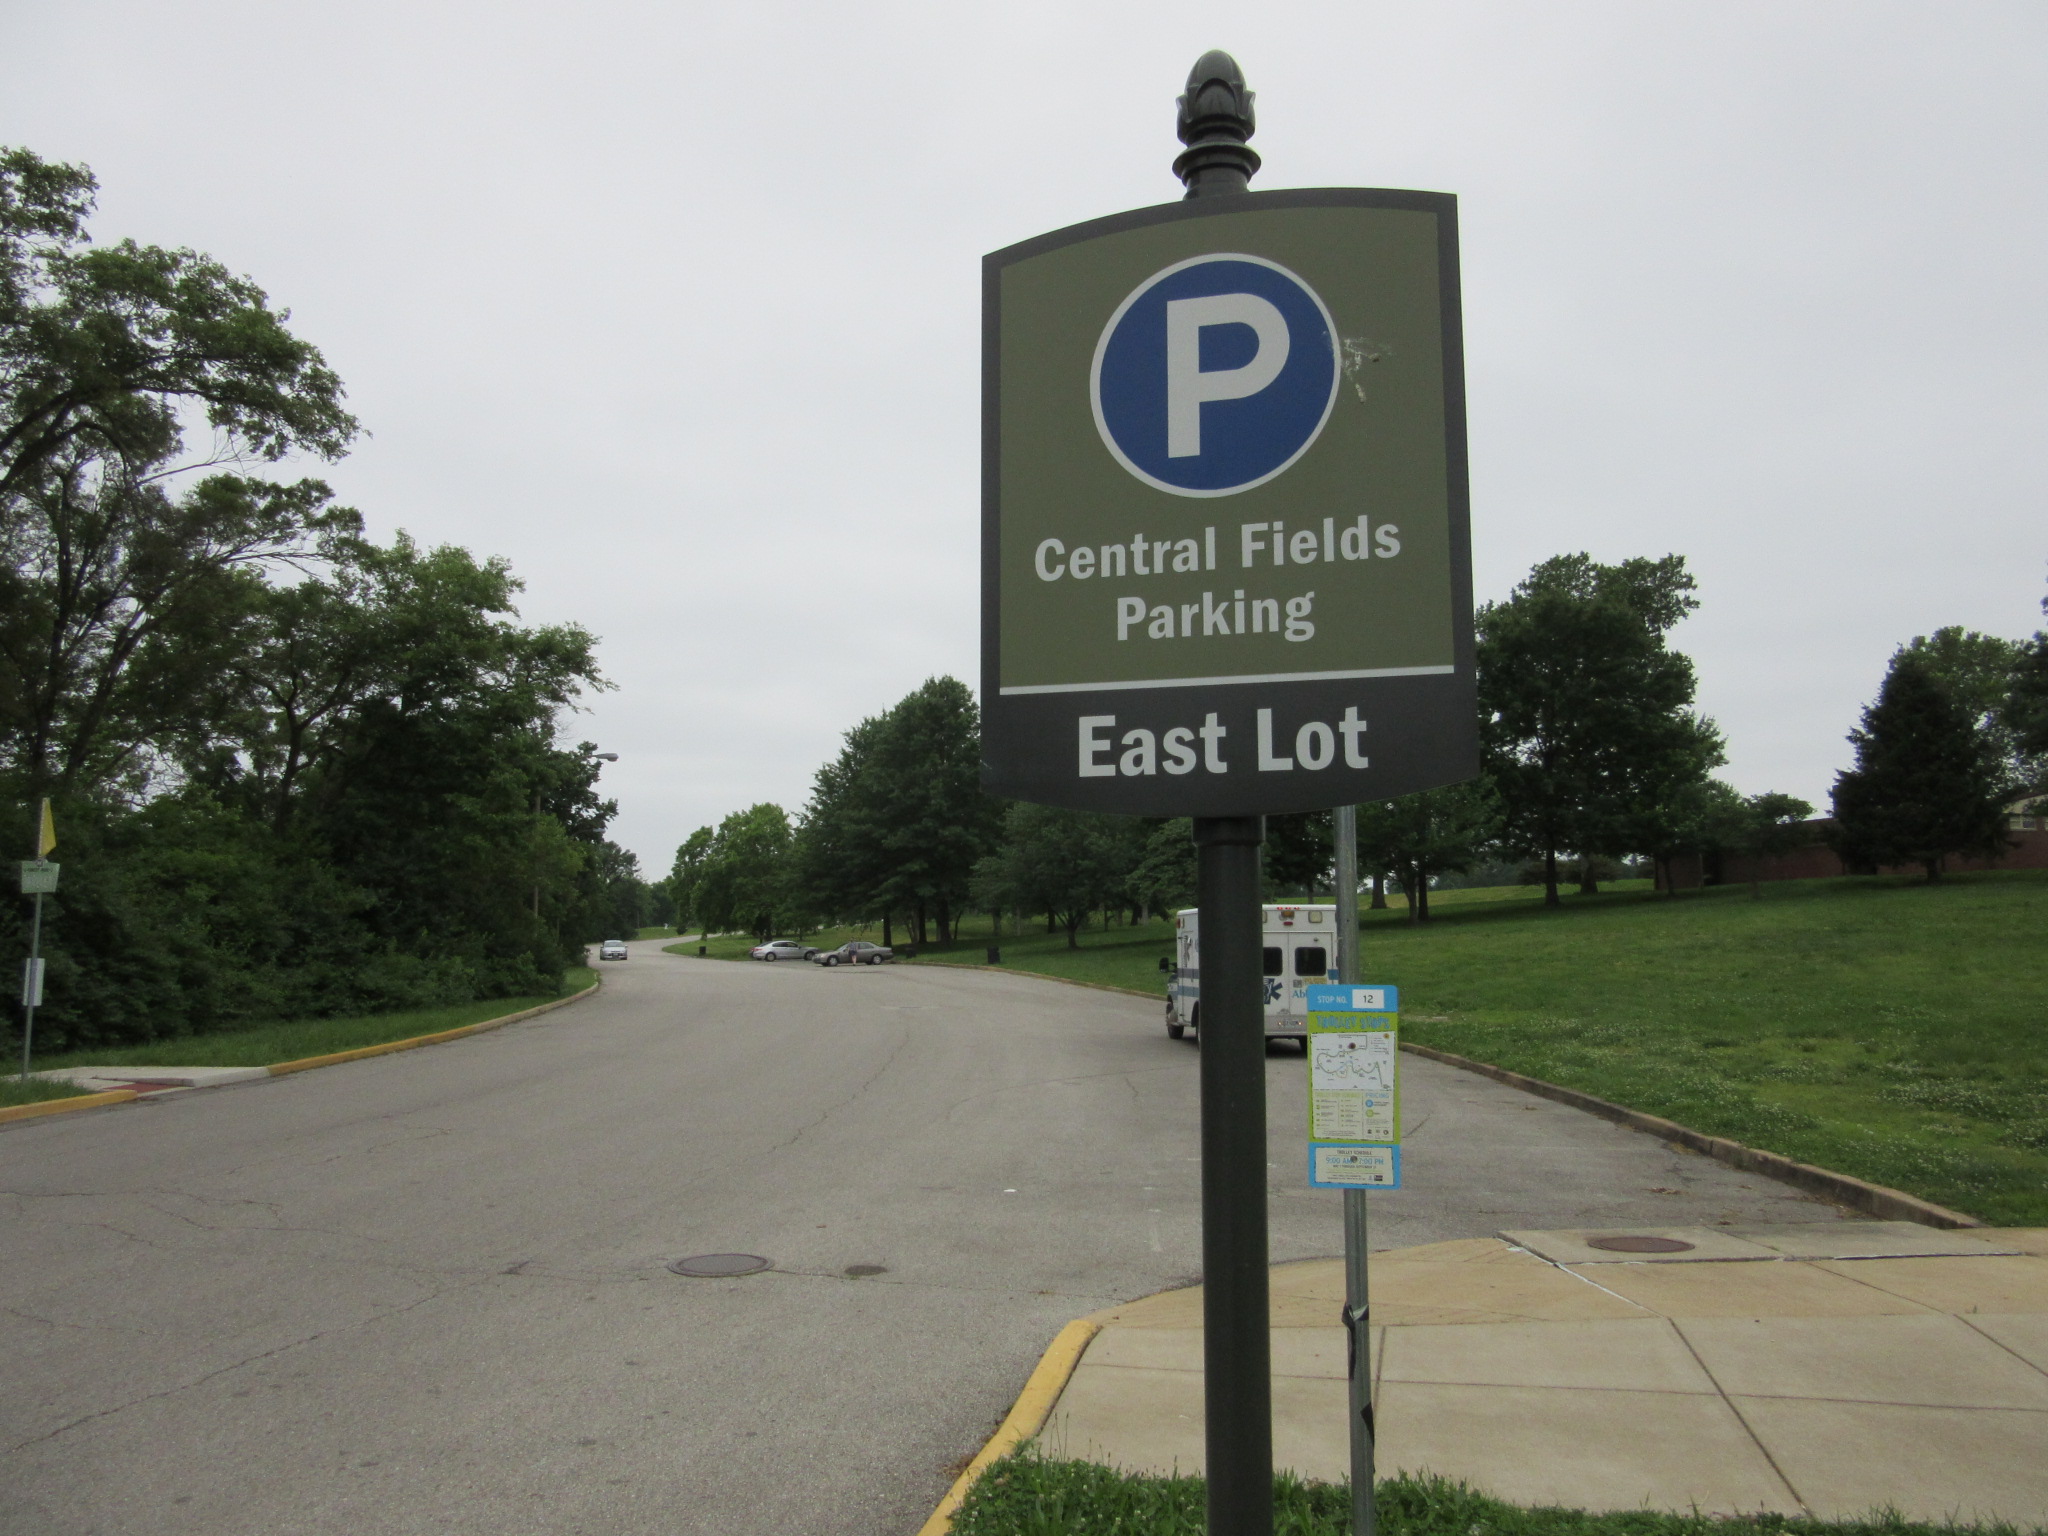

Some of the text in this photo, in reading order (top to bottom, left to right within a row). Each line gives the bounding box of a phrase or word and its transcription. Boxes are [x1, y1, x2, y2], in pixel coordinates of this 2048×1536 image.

[1167, 292, 1290, 458] P
[1034, 514, 1401, 582] Central Fields
[1117, 588, 1316, 643] Parking
[1078, 706, 1369, 778] East Lot
[1316, 1015, 1357, 1029] TROLLEY
[1360, 1015, 1390, 1029] STOPS
[1317, 995, 1335, 1004] STOP
[1363, 994, 1374, 1004] 12
